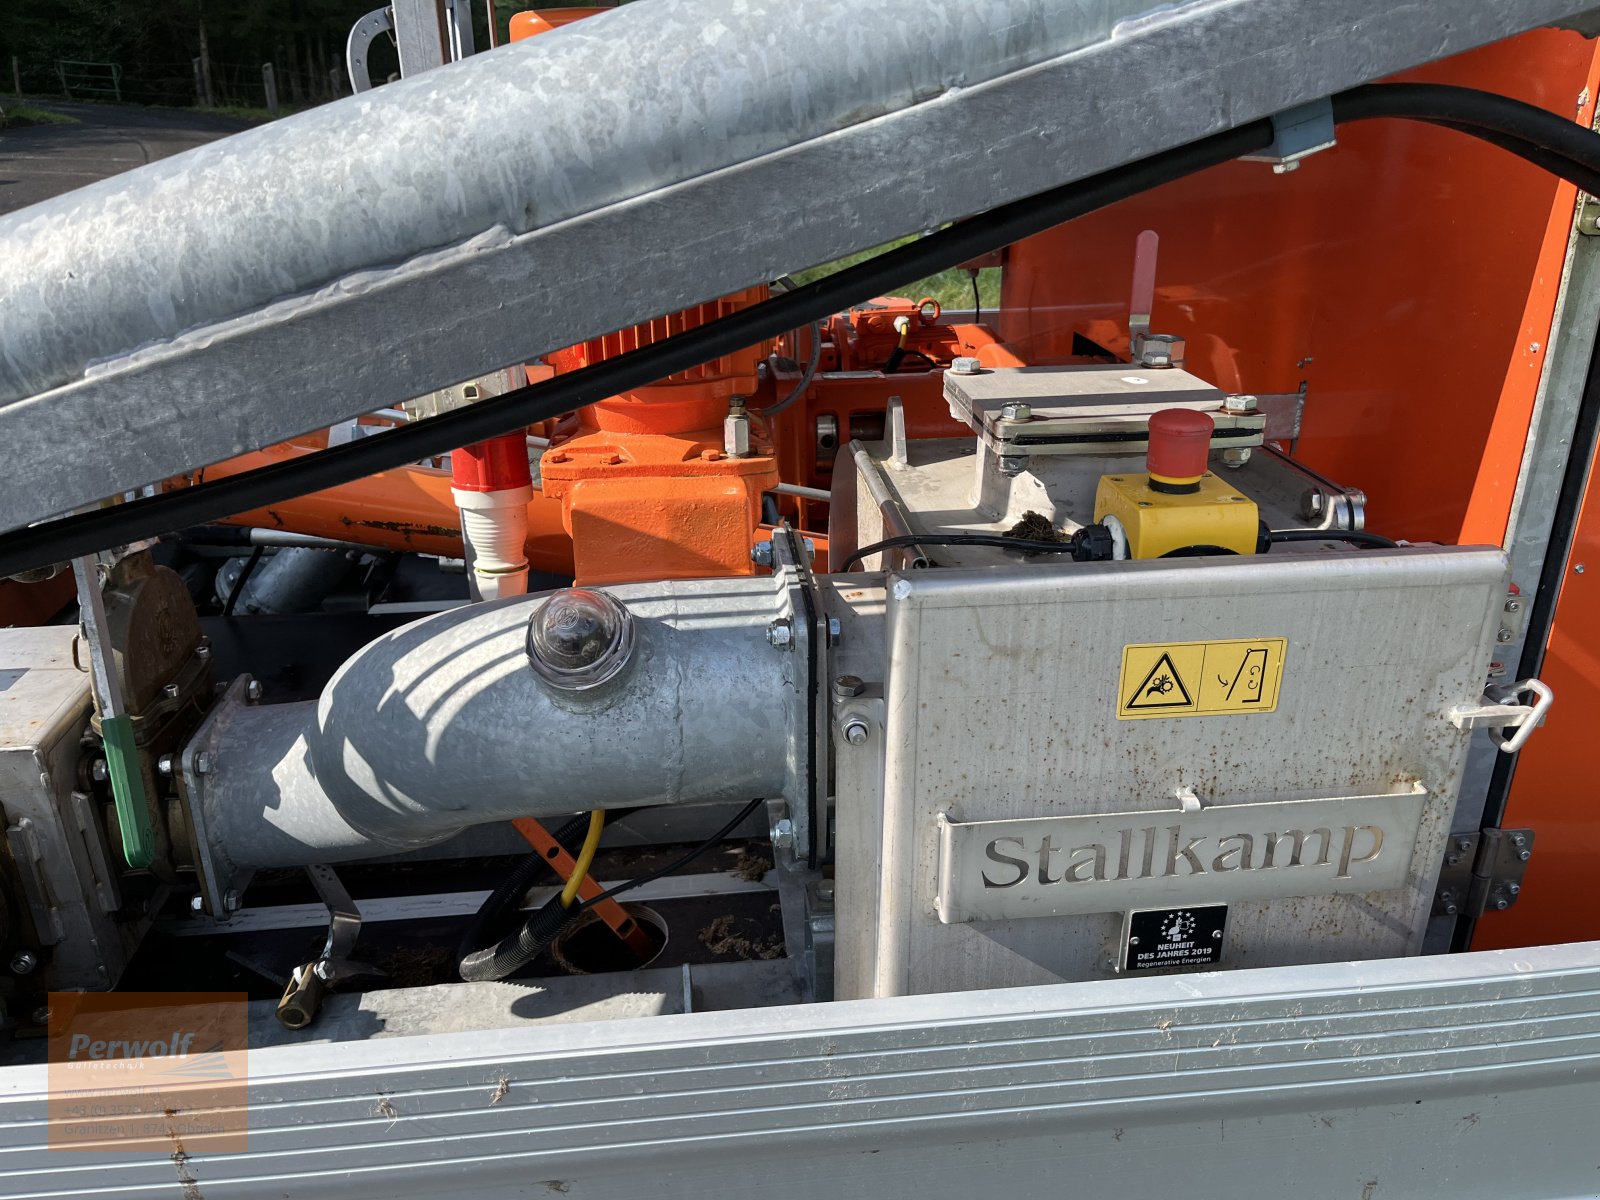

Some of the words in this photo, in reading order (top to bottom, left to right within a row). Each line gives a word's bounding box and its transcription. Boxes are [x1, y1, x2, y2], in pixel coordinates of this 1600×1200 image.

[981, 824, 1385, 889] Stallkamp
[1157, 941, 1195, 950] NEUHEIT
[1157, 949, 1190, 959] JAHRES
[1191, 947, 1212, 956] 2019
[1137, 959, 1180, 967] Regenerative
[1181, 956, 1211, 965] Energien
